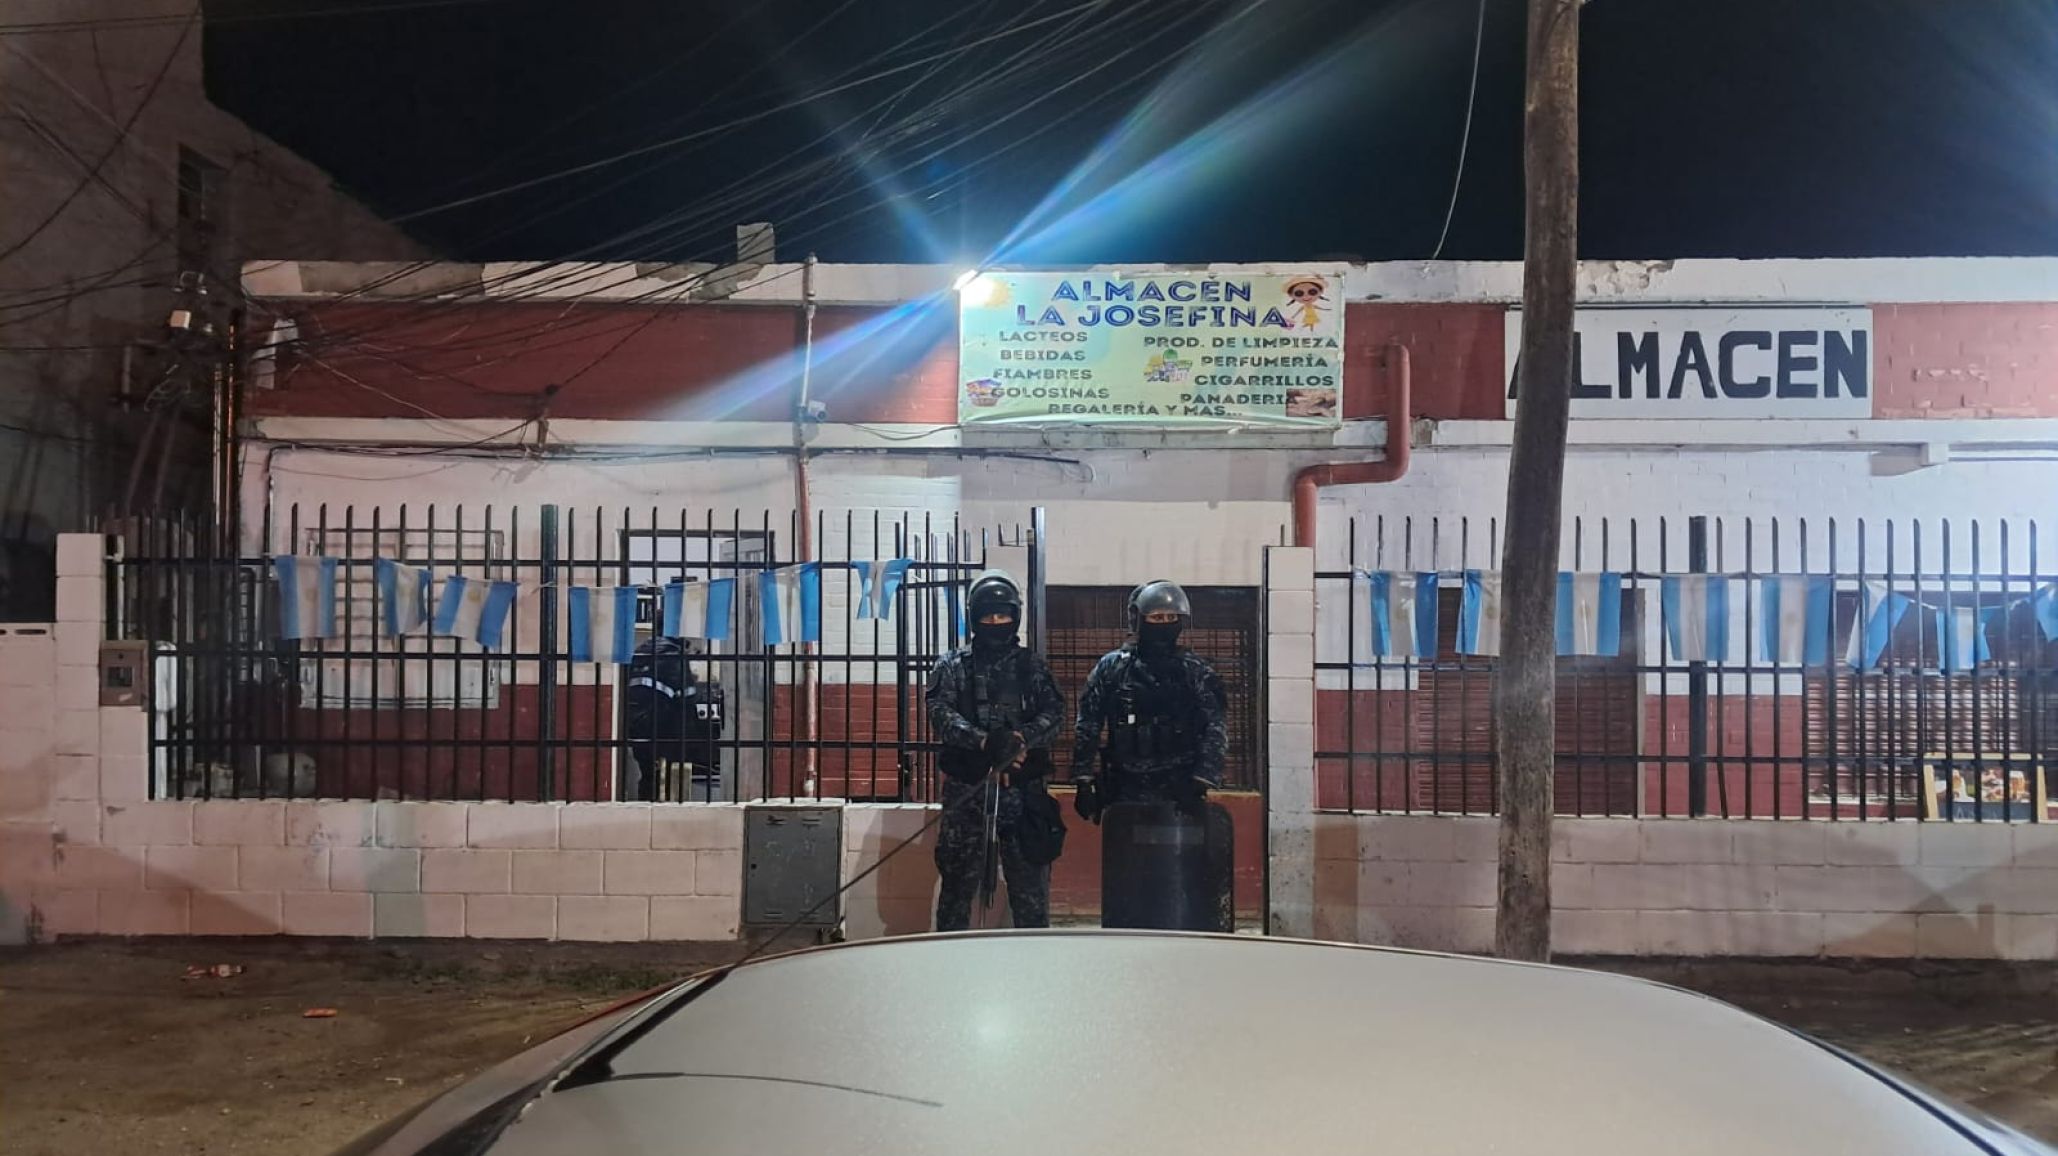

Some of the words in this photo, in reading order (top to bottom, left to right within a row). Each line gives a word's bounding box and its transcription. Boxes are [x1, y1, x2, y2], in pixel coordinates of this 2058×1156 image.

[1016, 305, 1066, 327] LA
[1078, 304, 1288, 328] JOSEFINA
[999, 331, 1088, 342] LACTEOS
[1143, 336, 1205, 348] PROD.
[1212, 336, 1236, 348] DE
[1243, 337, 1339, 349] LIMPIEZA
[1000, 349, 1086, 361] BEBIDAS
[1200, 353, 1328, 368] PERFUMERÍA
[1508, 329, 1867, 399] LMACEN
[993, 368, 1093, 380] FIAMBRES
[1194, 375, 1335, 387] CIGARRILLOS
[990, 387, 1110, 399] GOLOSINAS
[1048, 401, 1159, 416] REGALERÍA
[1165, 405, 1178, 416] Y
